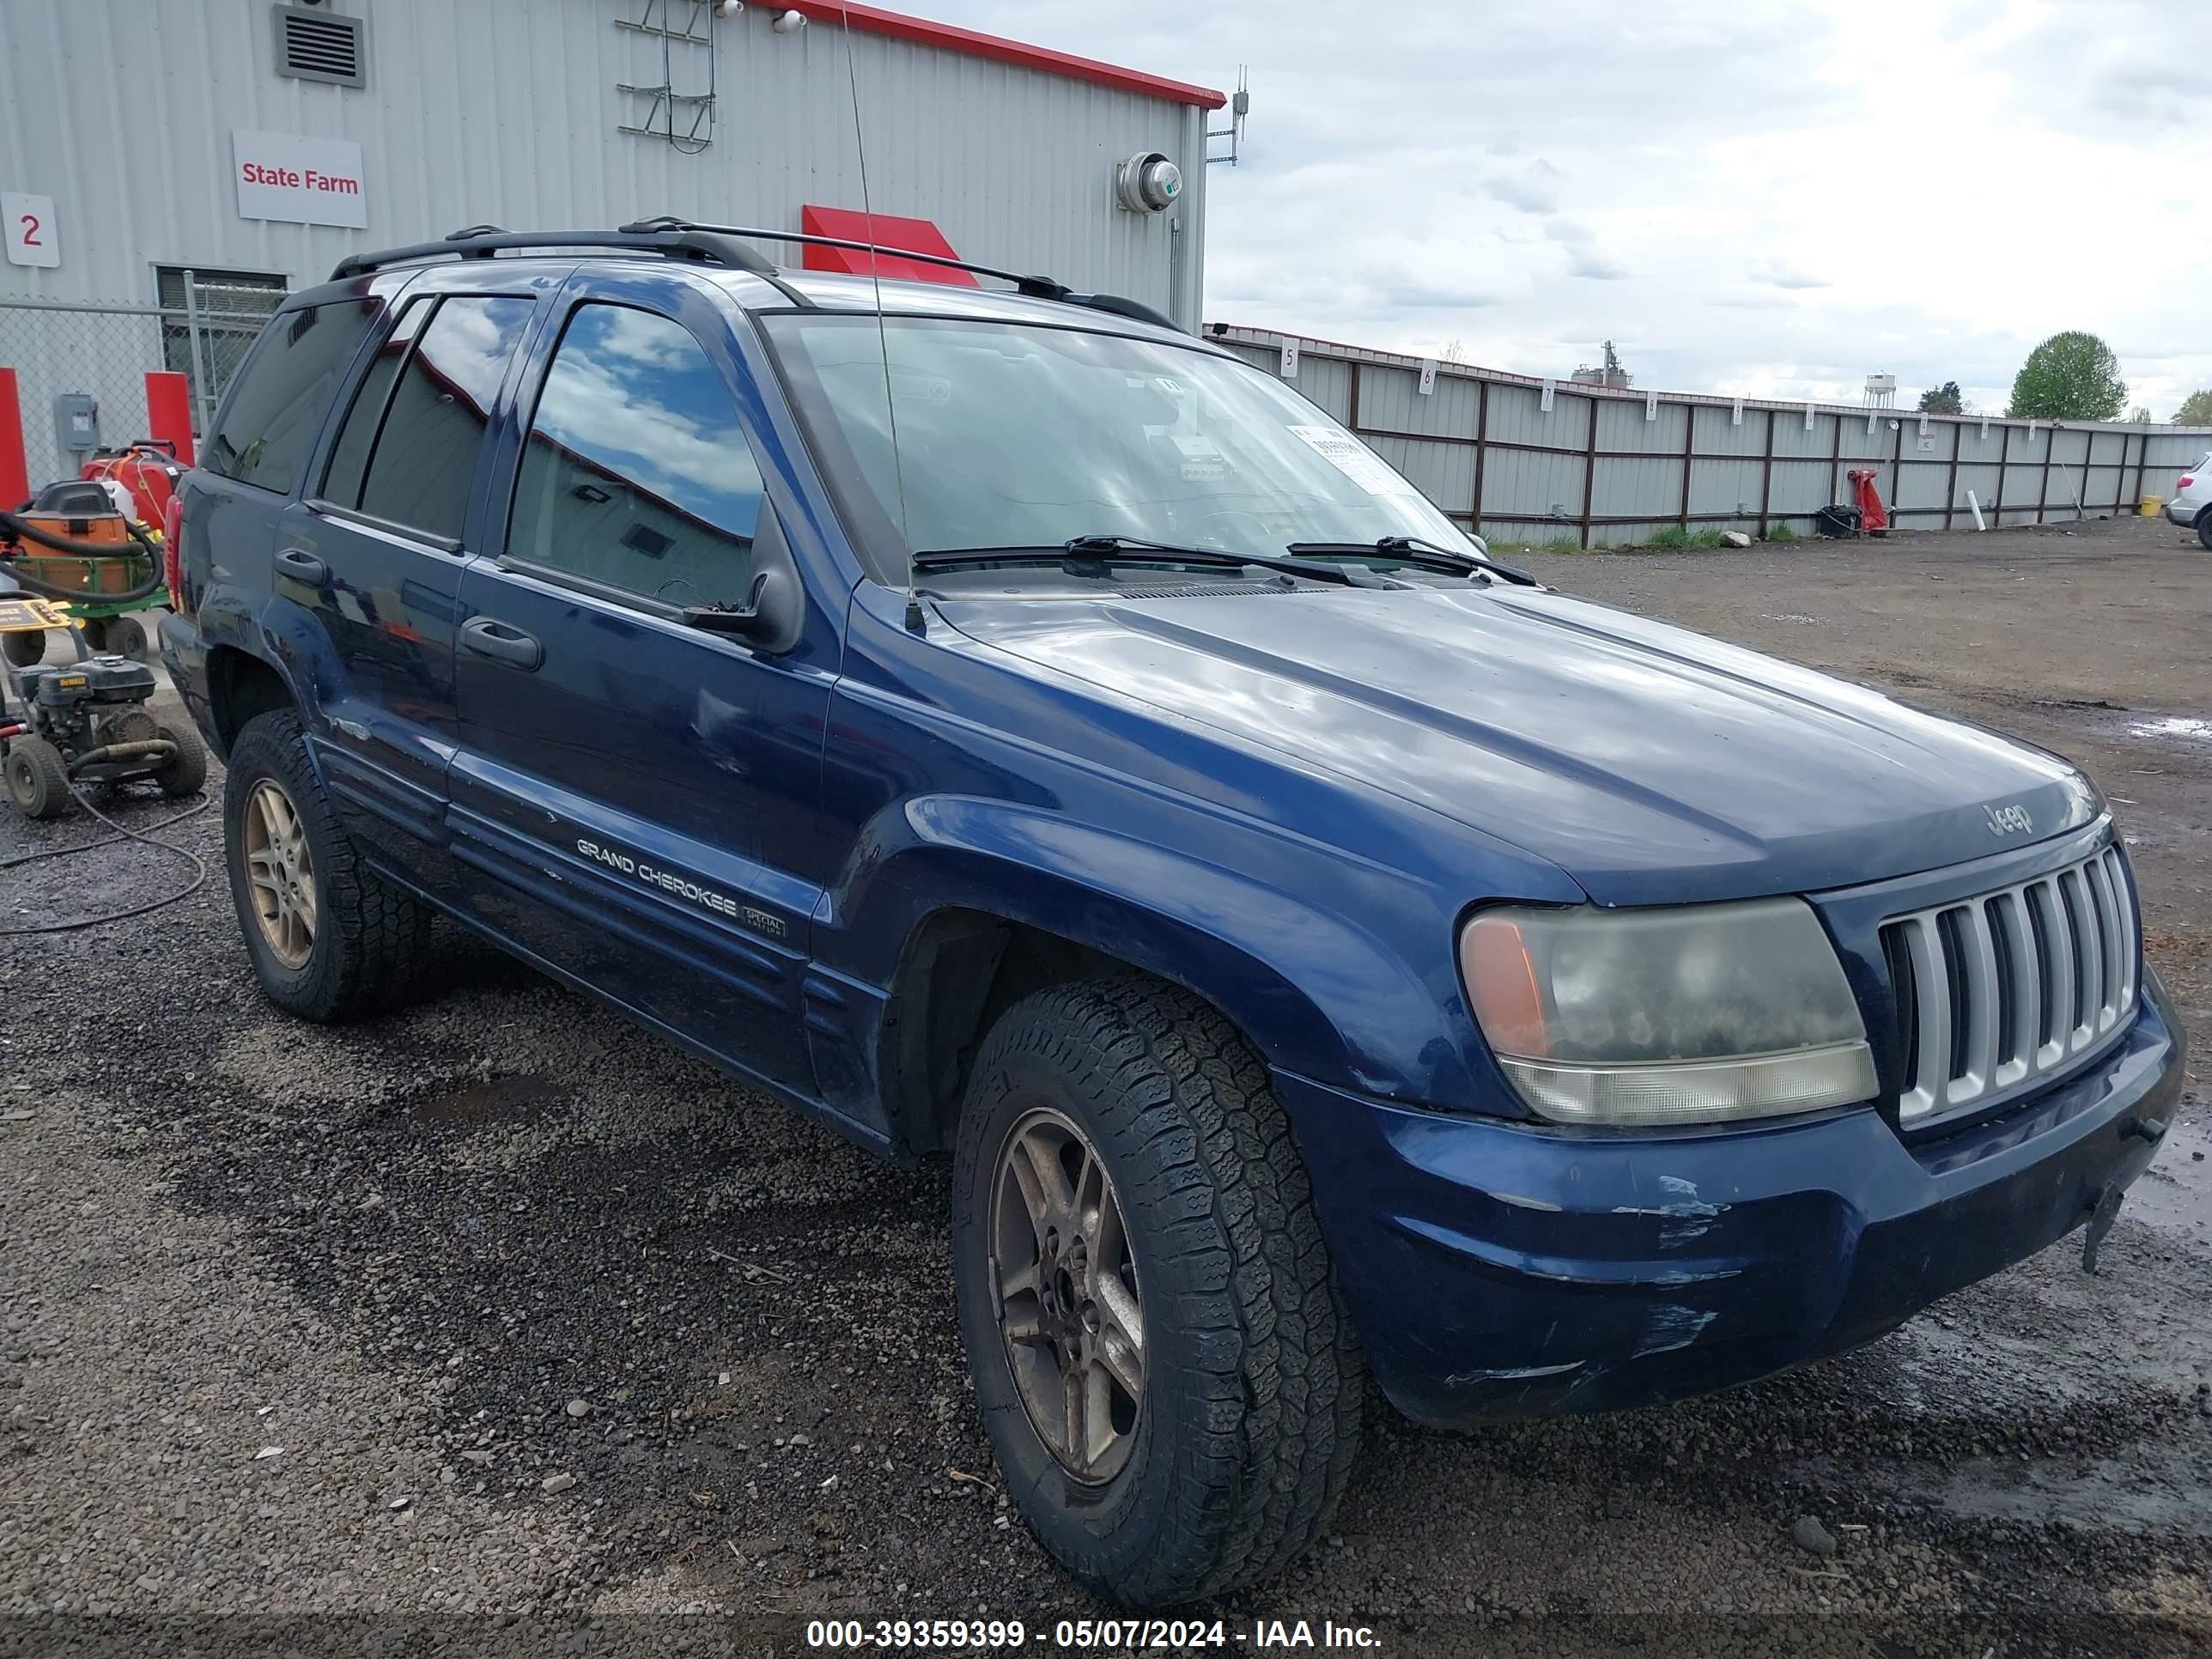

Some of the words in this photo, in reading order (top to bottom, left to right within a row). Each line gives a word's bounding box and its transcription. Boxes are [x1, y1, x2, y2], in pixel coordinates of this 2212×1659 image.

[243, 163, 300, 187] State
[305, 170, 358, 194] Farm
[21, 215, 41, 246] 2
[1286, 349, 1293, 366] 5
[1425, 369, 1431, 385] 6
[1546, 387, 1551, 403] 7
[1649, 399, 1654, 412] 8
[1736, 404, 1741, 416] 9
[1808, 411, 1813, 422] 10
[1982, 805, 2033, 836] Jeep
[577, 839, 635, 874] GRAND
[639, 864, 737, 917] CHEROKEE
[746, 910, 782, 930] SPECIAL
